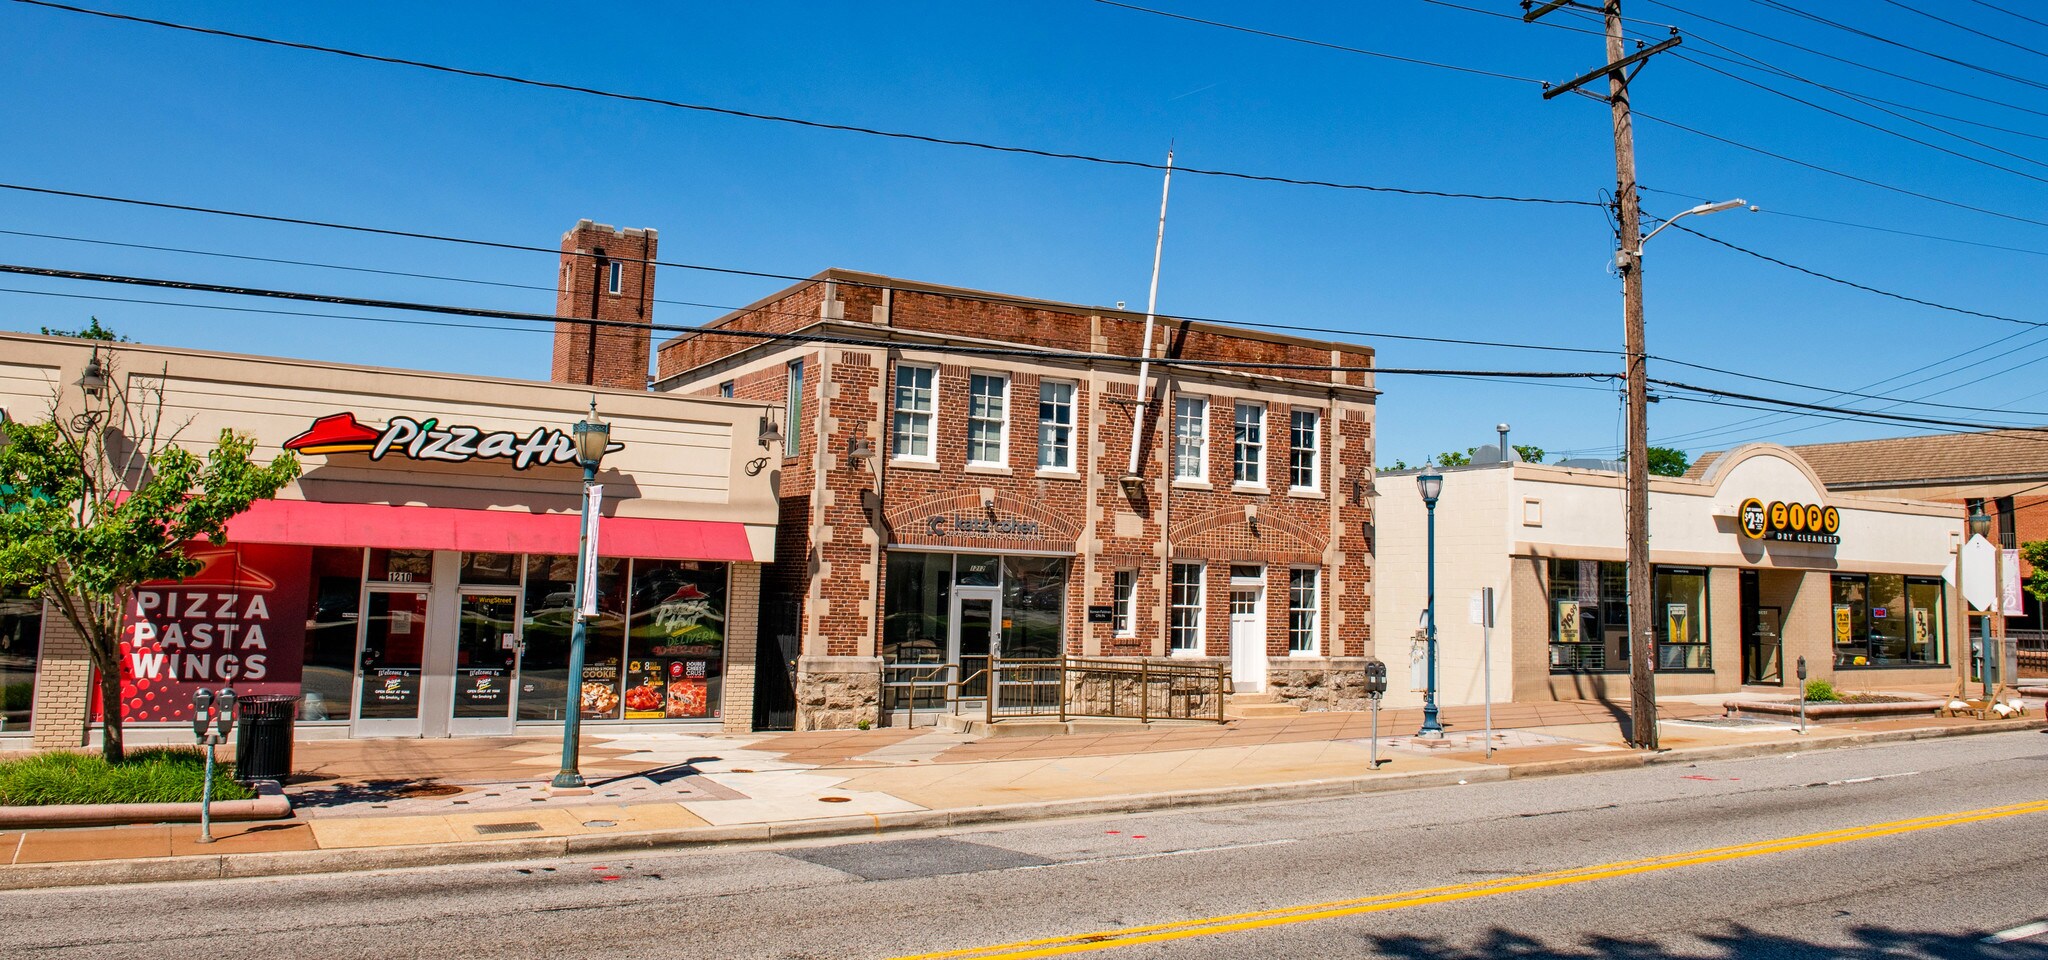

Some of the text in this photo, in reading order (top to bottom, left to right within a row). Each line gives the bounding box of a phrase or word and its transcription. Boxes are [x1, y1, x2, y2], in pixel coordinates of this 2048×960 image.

[372, 416, 624, 469] Pizza Hu
[954, 514, 1039, 534] katz cohen
[1775, 507, 1835, 529] ZIPS
[1777, 532, 1838, 543] DRY CLEANERS
[389, 572, 412, 582] 1210
[136, 592, 269, 619] PIZZA
[480, 596, 512, 604] WingStreet
[1561, 603, 1578, 629] $19.99
[133, 622, 267, 649] PASTA
[667, 631, 715, 646] DELIVERY
[131, 653, 267, 679] WINGS
[582, 670, 616, 678] COOKIE
[644, 661, 650, 671] 8
[643, 676, 649, 686] 2
